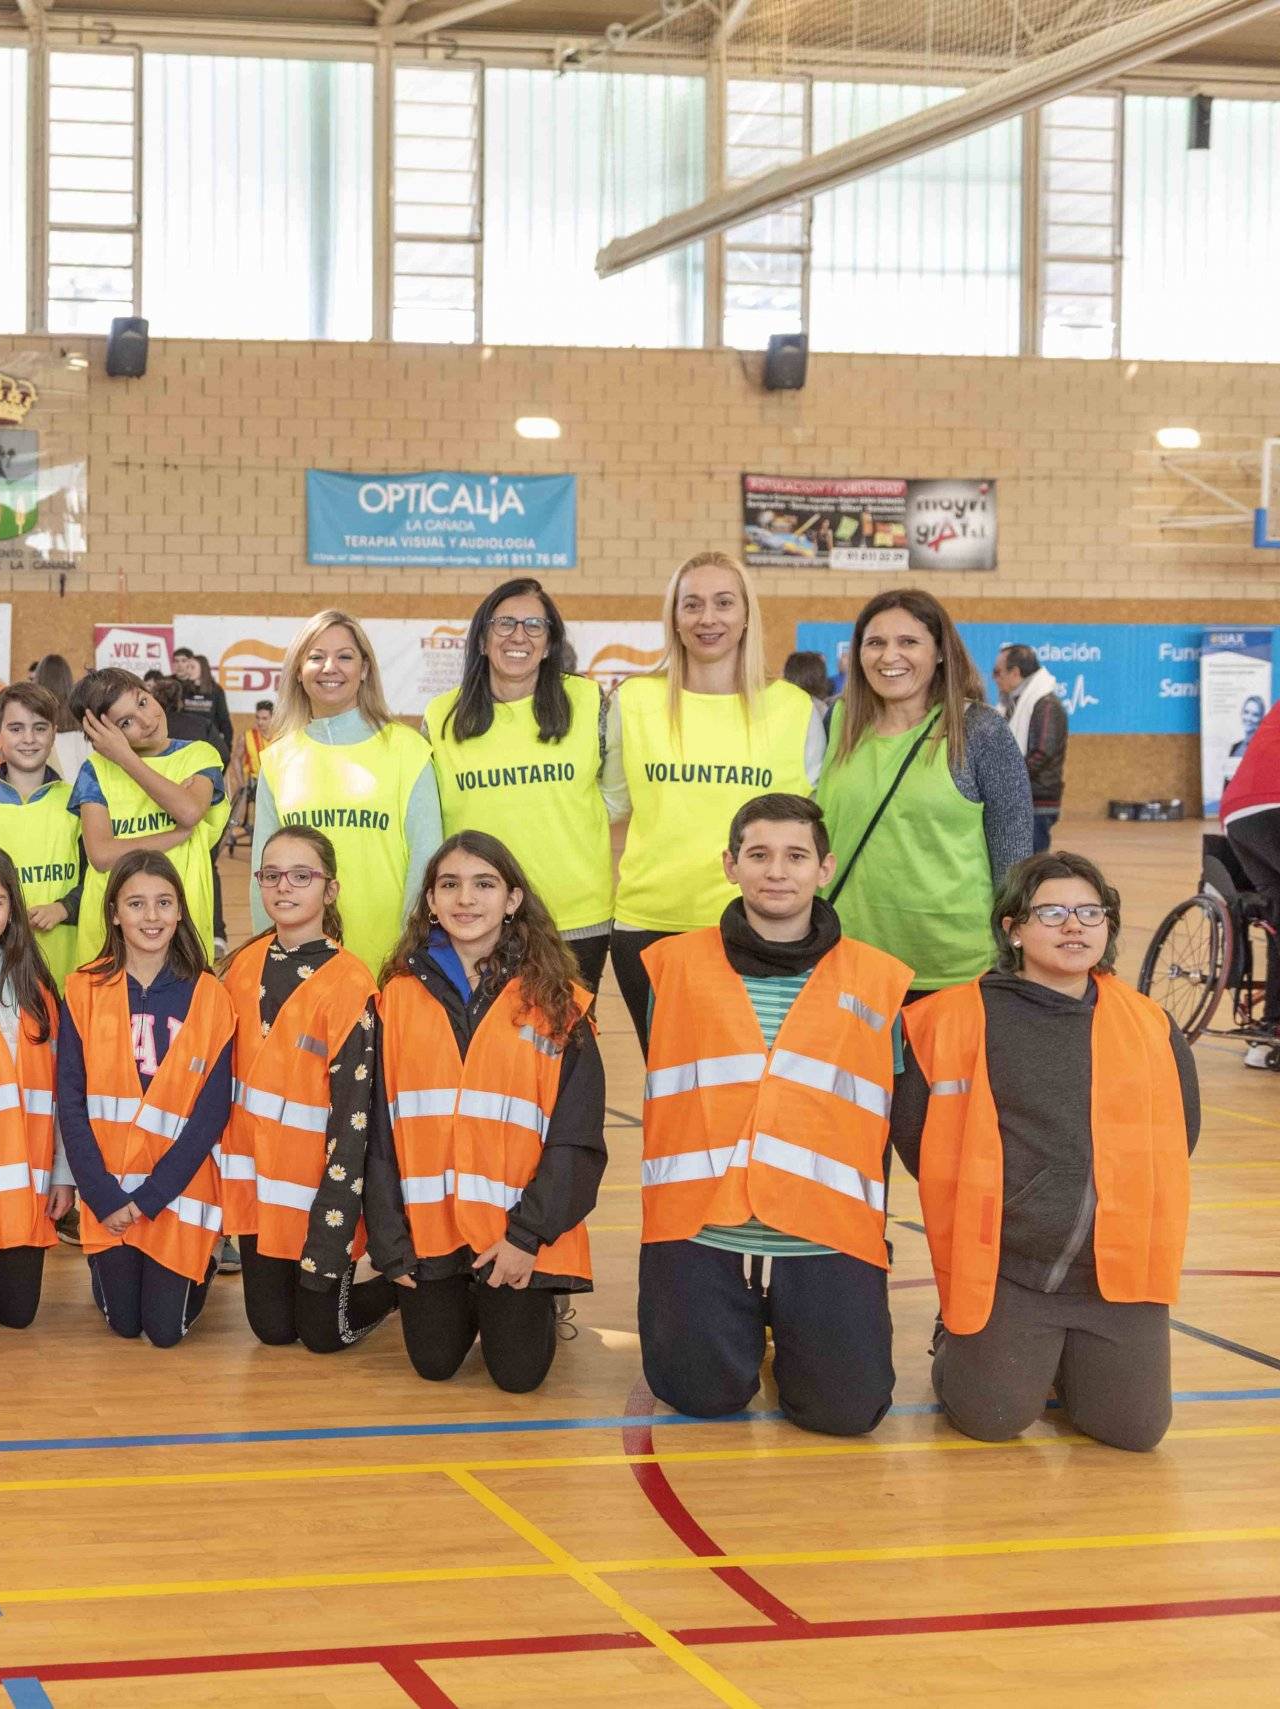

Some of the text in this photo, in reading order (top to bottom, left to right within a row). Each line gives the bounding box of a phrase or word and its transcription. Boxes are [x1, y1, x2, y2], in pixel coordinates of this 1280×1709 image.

[406, 520, 423, 532] LA
[344, 534, 537, 551] TERAPIA VISUAL Y AUDIOLOGÍA
[10, 560, 24, 570] LA
[455, 762, 576, 792] VOLUNTARIO
[644, 762, 773, 789] VOLUNTARIO
[282, 808, 390, 832] VOLUNTARIO
[17, 863, 76, 885] NTARIO
